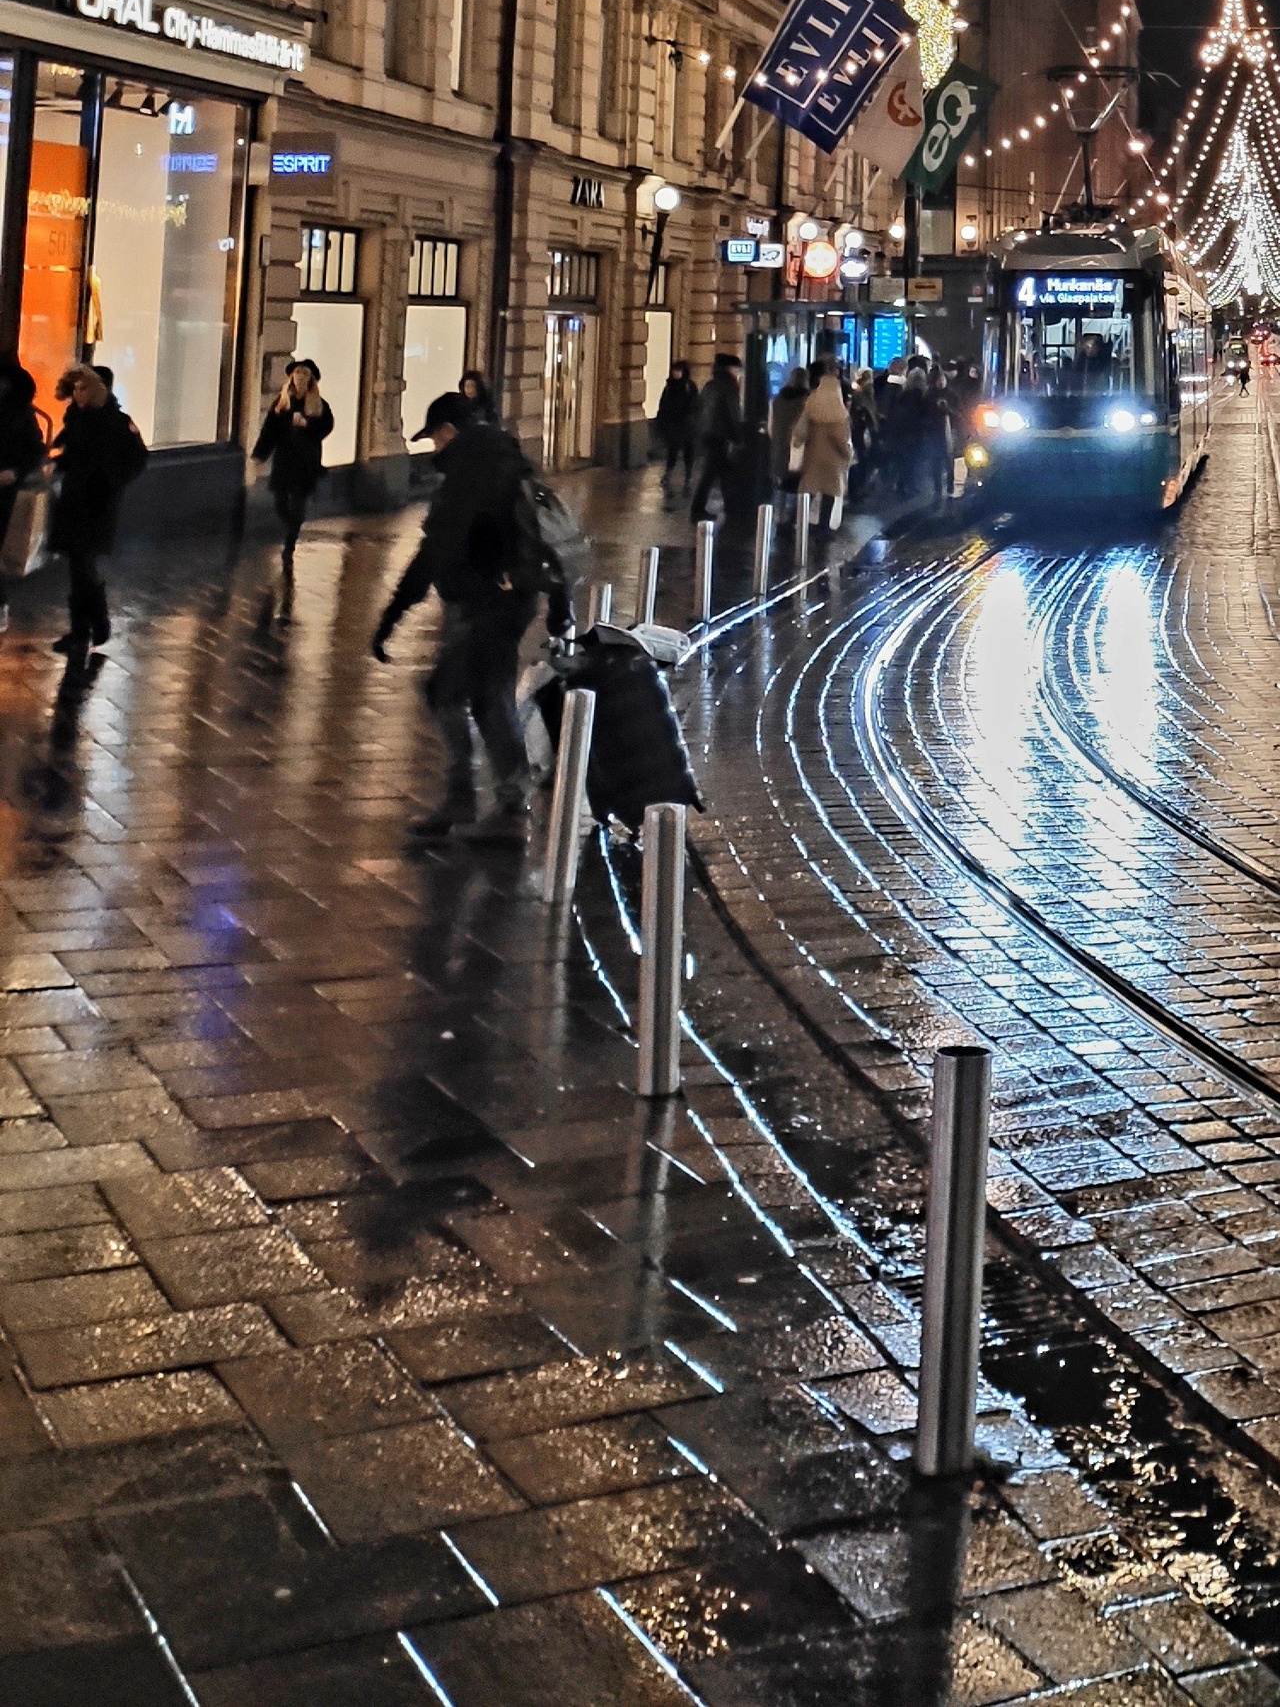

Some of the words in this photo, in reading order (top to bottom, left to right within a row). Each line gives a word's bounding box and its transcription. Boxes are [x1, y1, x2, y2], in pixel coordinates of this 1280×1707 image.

[817, 27, 885, 114] EVLI
[272, 153, 331, 174] ESPRIT
[570, 176, 605, 208] ZARA
[1018, 277, 1036, 307] 4
